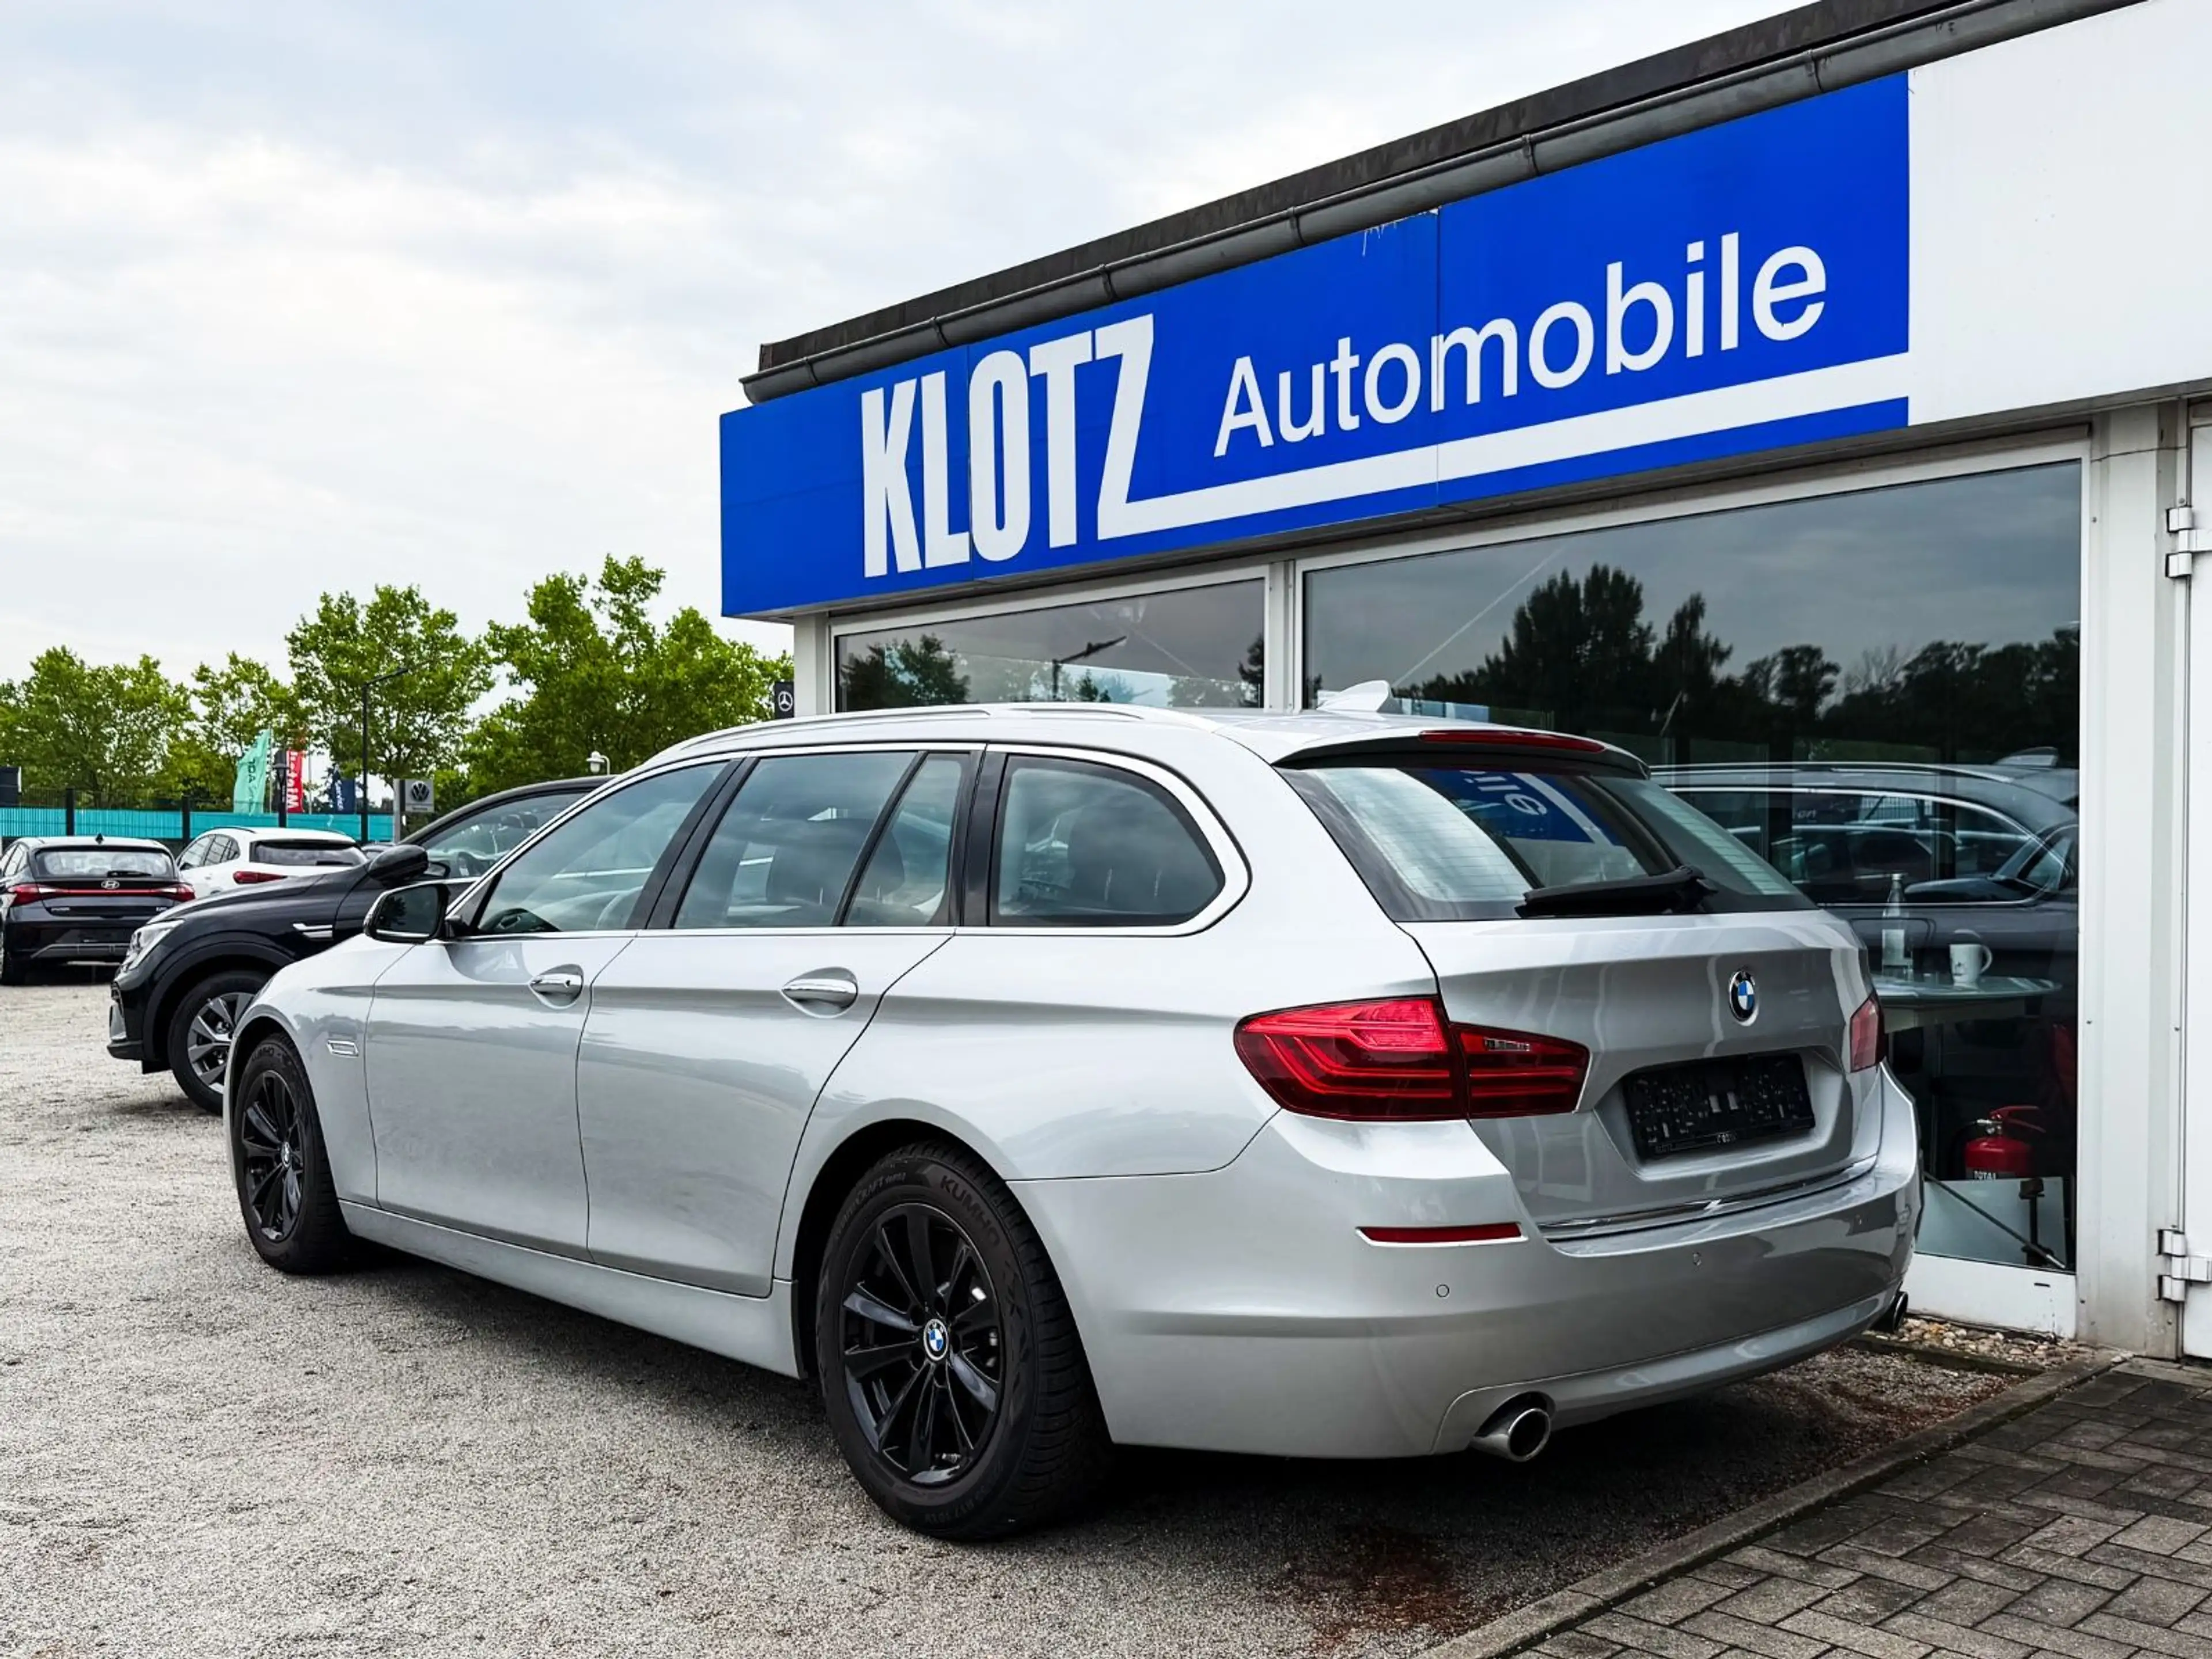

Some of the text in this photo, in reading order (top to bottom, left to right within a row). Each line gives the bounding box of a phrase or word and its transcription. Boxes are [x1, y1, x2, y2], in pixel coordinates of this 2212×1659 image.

[861, 232, 1827, 578] KLOTZ Automobile
[940, 1175, 1001, 1247] KUMHO
